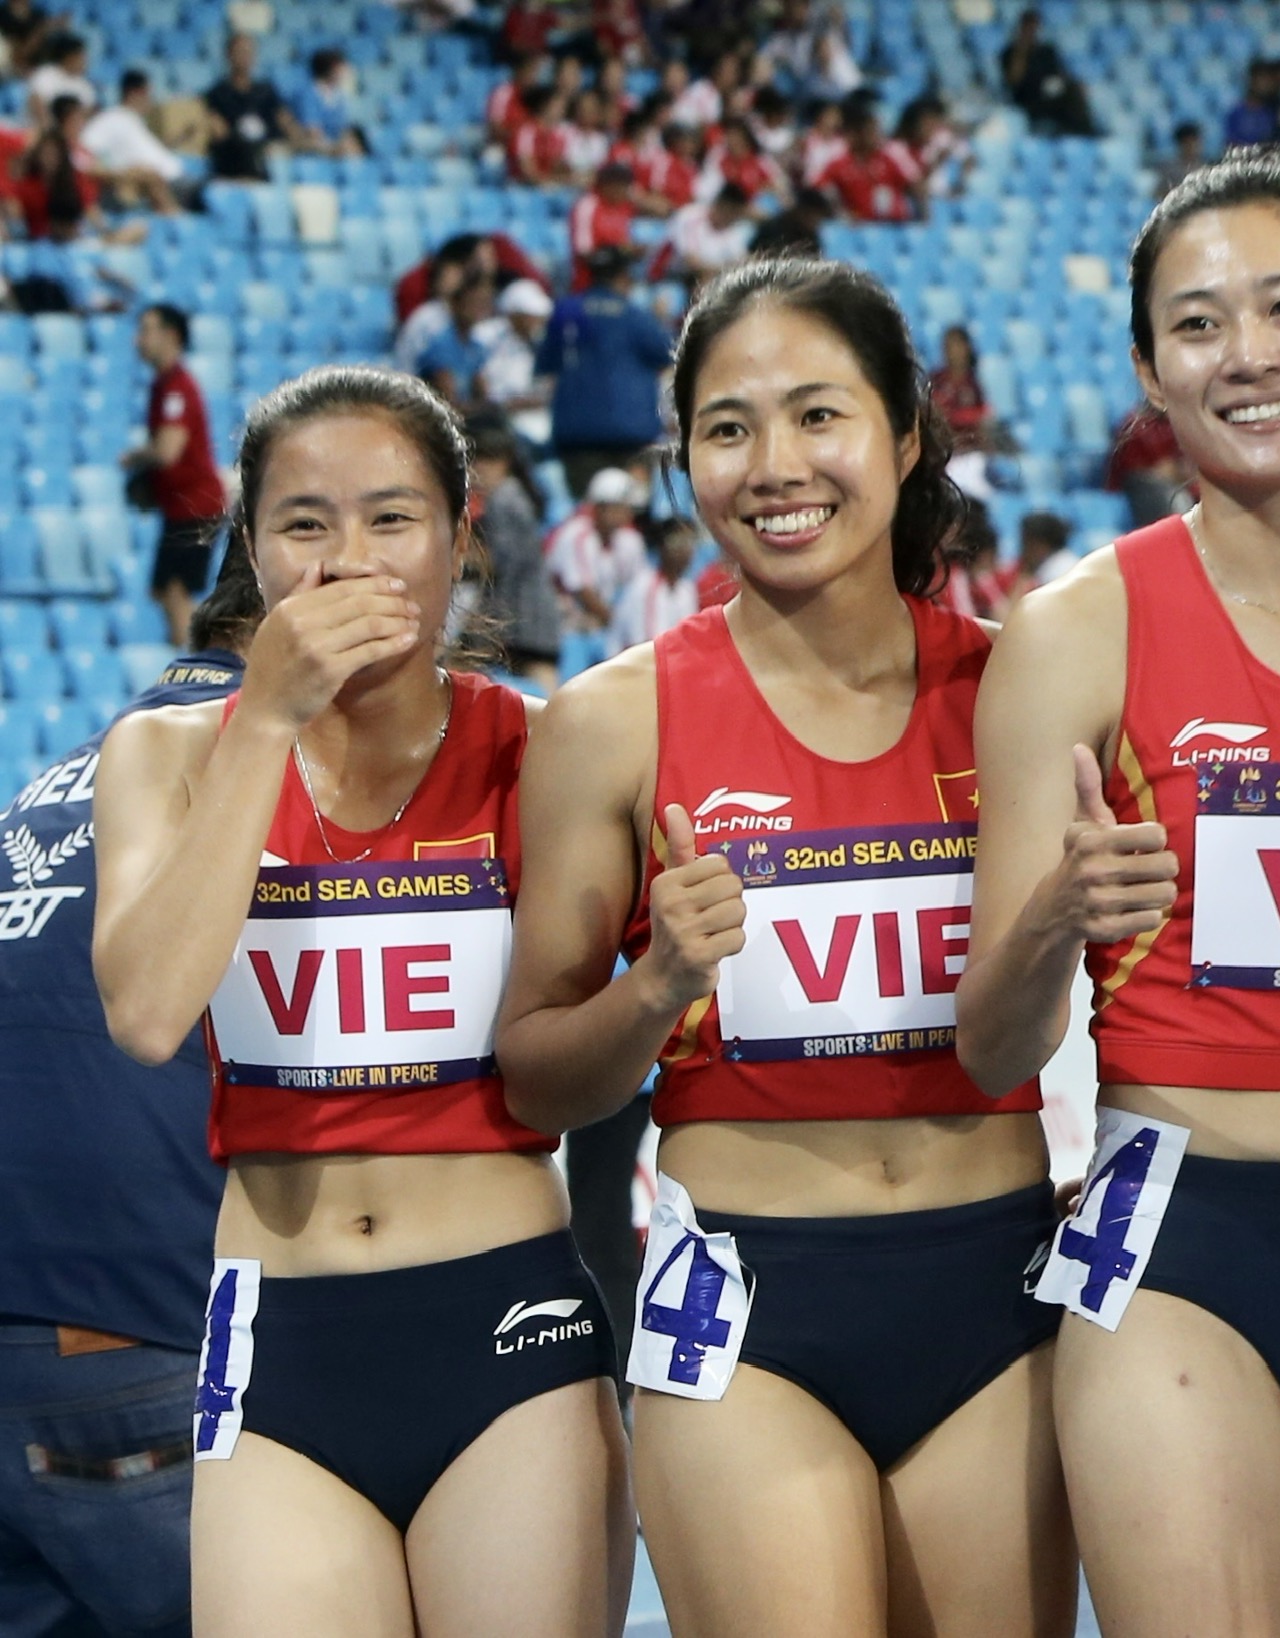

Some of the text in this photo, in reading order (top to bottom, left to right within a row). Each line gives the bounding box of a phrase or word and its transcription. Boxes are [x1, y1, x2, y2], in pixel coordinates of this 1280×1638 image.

[188, 668, 233, 685] PEACE
[1172, 747, 1270, 767] LI-NING
[694, 815, 793, 834] LI-NING
[784, 837, 978, 870] 32nd SEA GAME
[256, 874, 471, 903] 32nd SEA GAMES
[772, 905, 971, 1004] VIE
[247, 943, 455, 1036] VIE
[909, 1031, 924, 1049] IN
[928, 1028, 956, 1047] PEA
[369, 1067, 386, 1085] IN
[391, 1064, 438, 1084] PEACE
[1058, 1127, 1160, 1314] 4
[641, 1228, 732, 1386] 4
[495, 1320, 593, 1355] LI-NING
